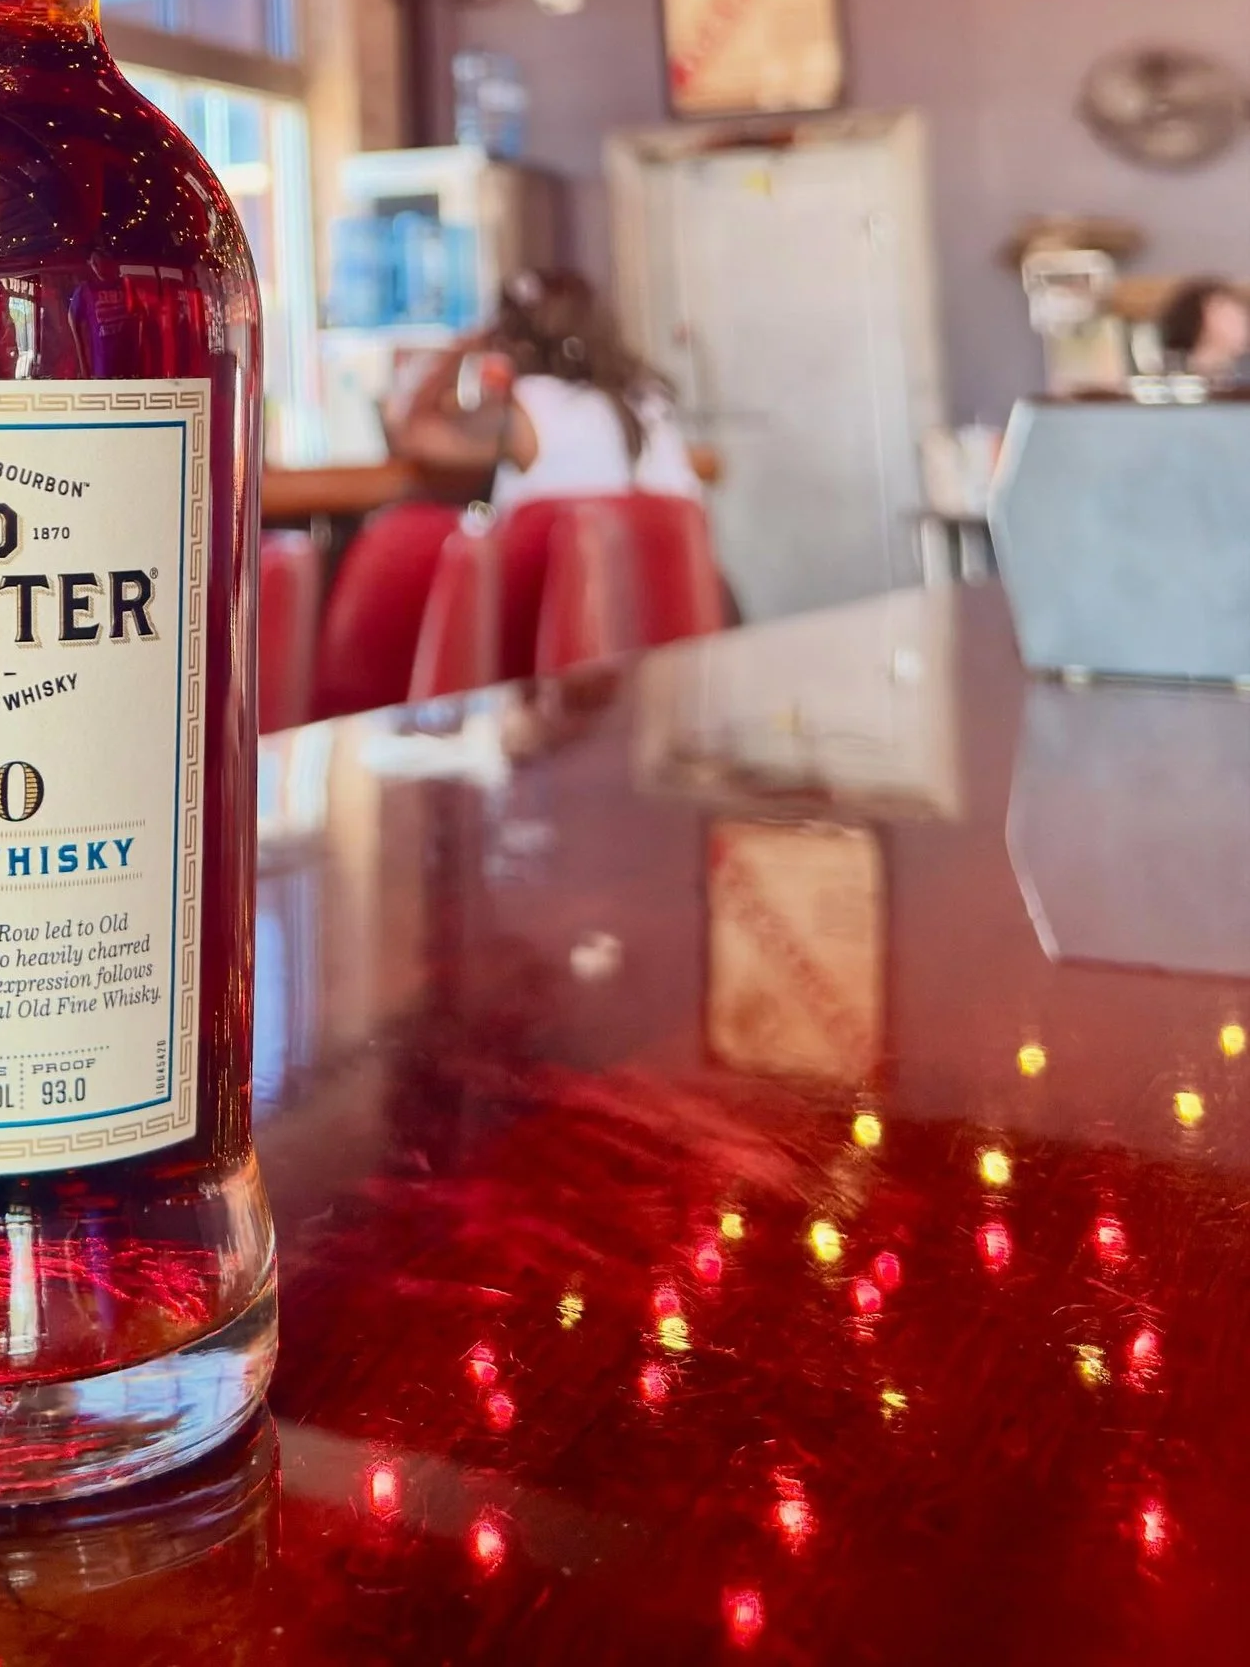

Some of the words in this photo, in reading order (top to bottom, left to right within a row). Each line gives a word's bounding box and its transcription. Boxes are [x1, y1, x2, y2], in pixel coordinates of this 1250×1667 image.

[33, 526, 70, 540] 1870
[2, 673, 78, 711] WHISKY
[45, 919, 72, 940] led
[77, 919, 94, 936] to
[99, 912, 129, 934] Old
[15, 944, 84, 967] heavily
[88, 933, 151, 961] charred
[94, 963, 154, 990] follows
[18, 998, 51, 1018] Old
[56, 995, 97, 1015] Fine
[102, 984, 161, 1009] Whisky.
[31, 1058, 96, 1075] PROOF
[42, 1077, 86, 1105] 93.0
